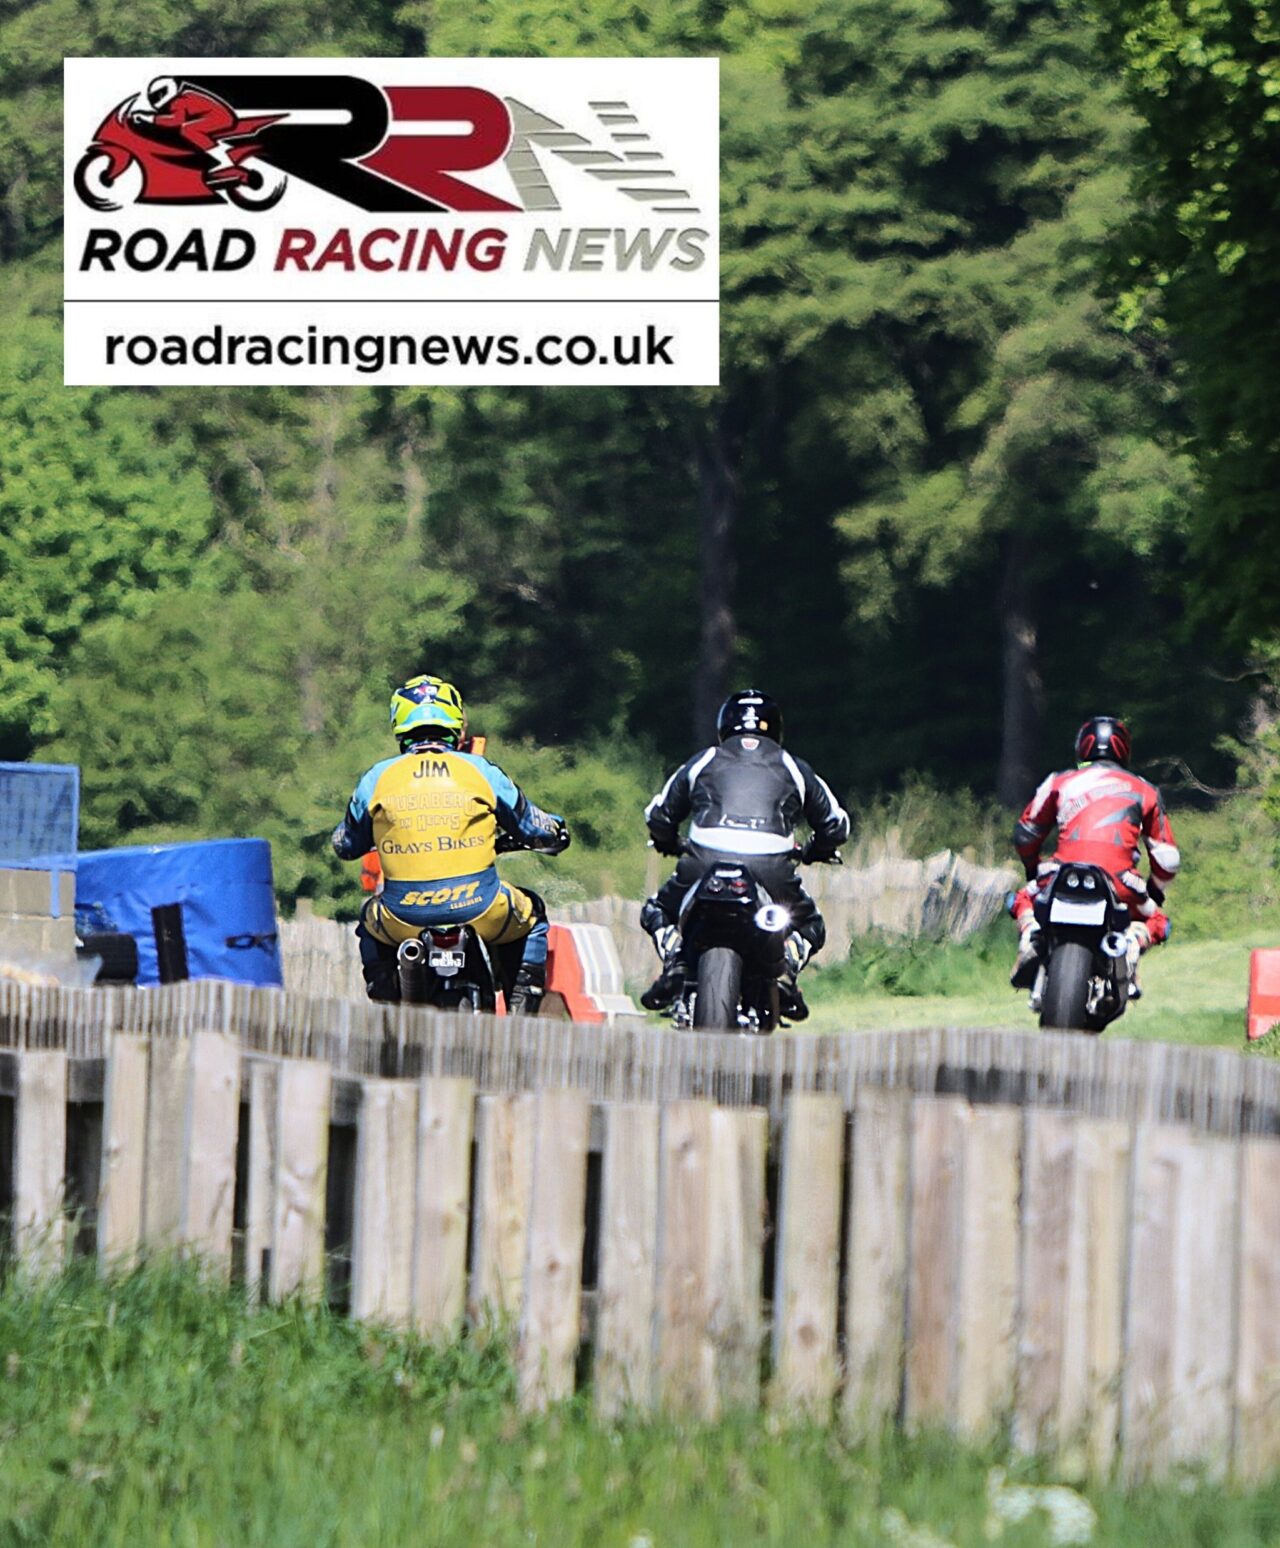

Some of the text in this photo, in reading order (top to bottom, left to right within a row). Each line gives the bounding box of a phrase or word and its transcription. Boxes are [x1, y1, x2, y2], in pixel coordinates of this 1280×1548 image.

[413, 759, 451, 779] JIM
[437, 835, 486, 852] BIKES
[400, 880, 481, 906] SCOTT
